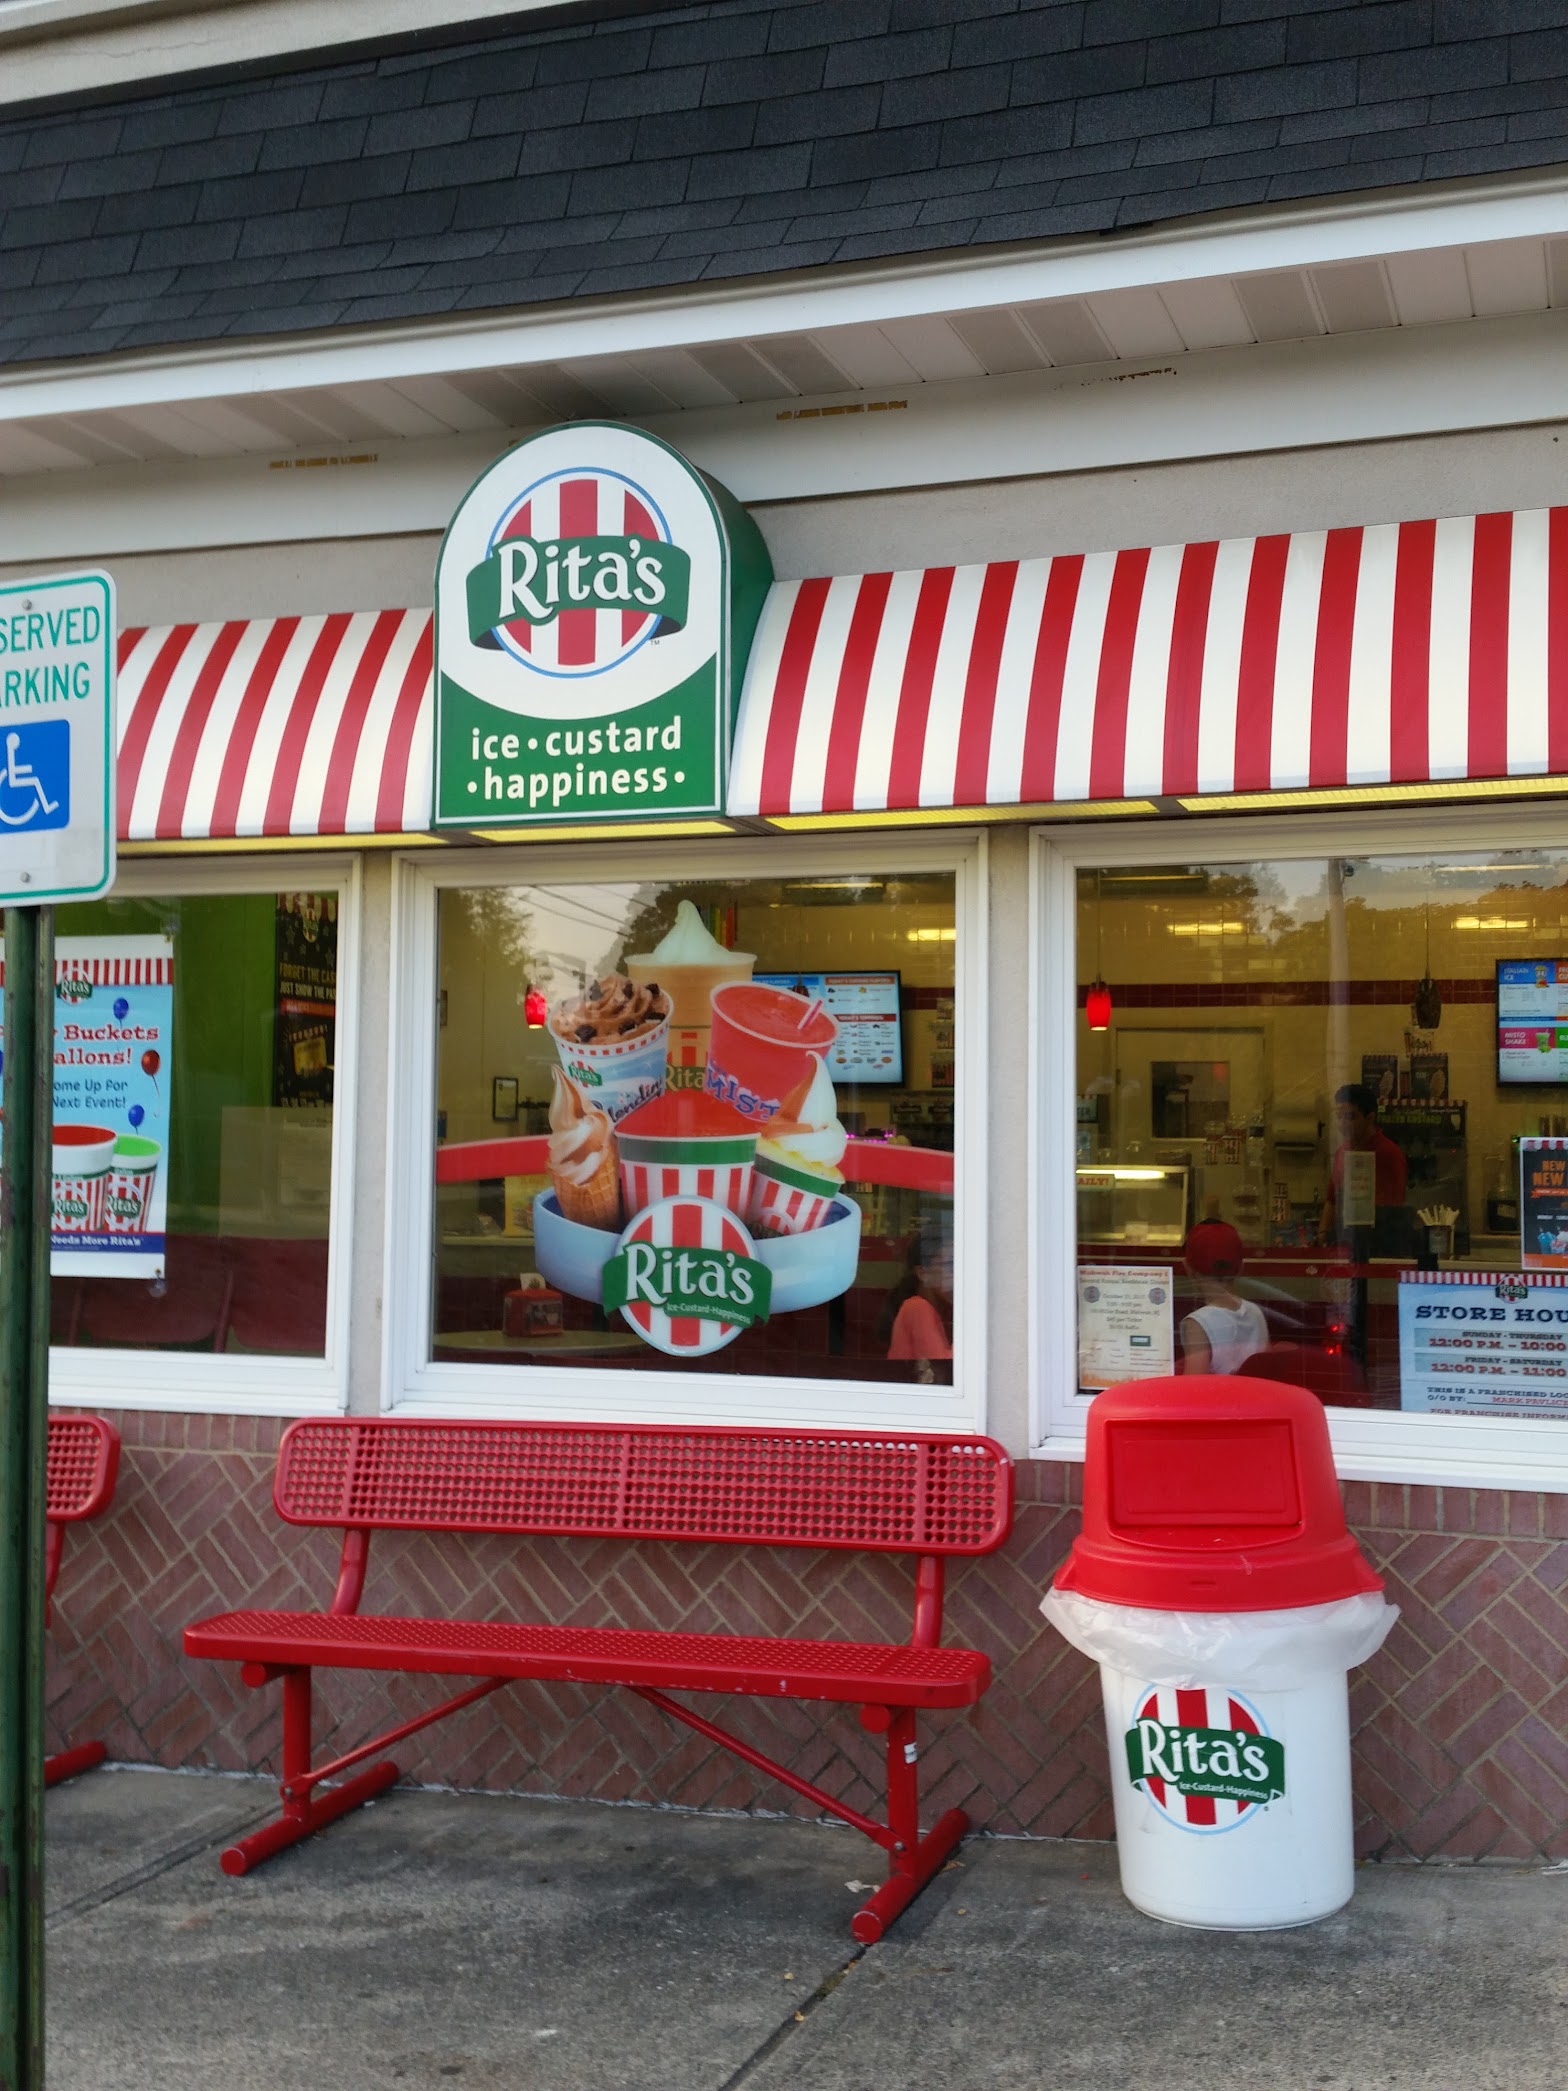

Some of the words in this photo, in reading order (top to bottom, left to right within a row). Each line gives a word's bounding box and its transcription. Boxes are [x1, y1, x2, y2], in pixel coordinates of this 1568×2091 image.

[498, 538, 666, 619] Rita's
[64, 1024, 159, 1041] Buckets
[85, 1079, 101, 1095] Up
[106, 1079, 128, 1091] For
[85, 1096, 126, 1109] Event!
[625, 1243, 754, 1305] Rita's
[1416, 1305, 1506, 1321] STORE
[1462, 1331, 1502, 1339] SUNDAY
[1509, 1332, 1562, 1340] THURSDAY
[1430, 1338, 1473, 1348] 12:00
[1521, 1341, 1566, 1351] 10:00
[1510, 1358, 1562, 1366] SATURDAY
[1431, 1363, 1475, 1373] 12:00
[1523, 1366, 1567, 1377] 11:00
[1478, 1389, 1547, 1398] FRANCHISED
[1455, 1410, 1520, 1418] FRANCHISE
[1137, 1719, 1269, 1783] Rita's
